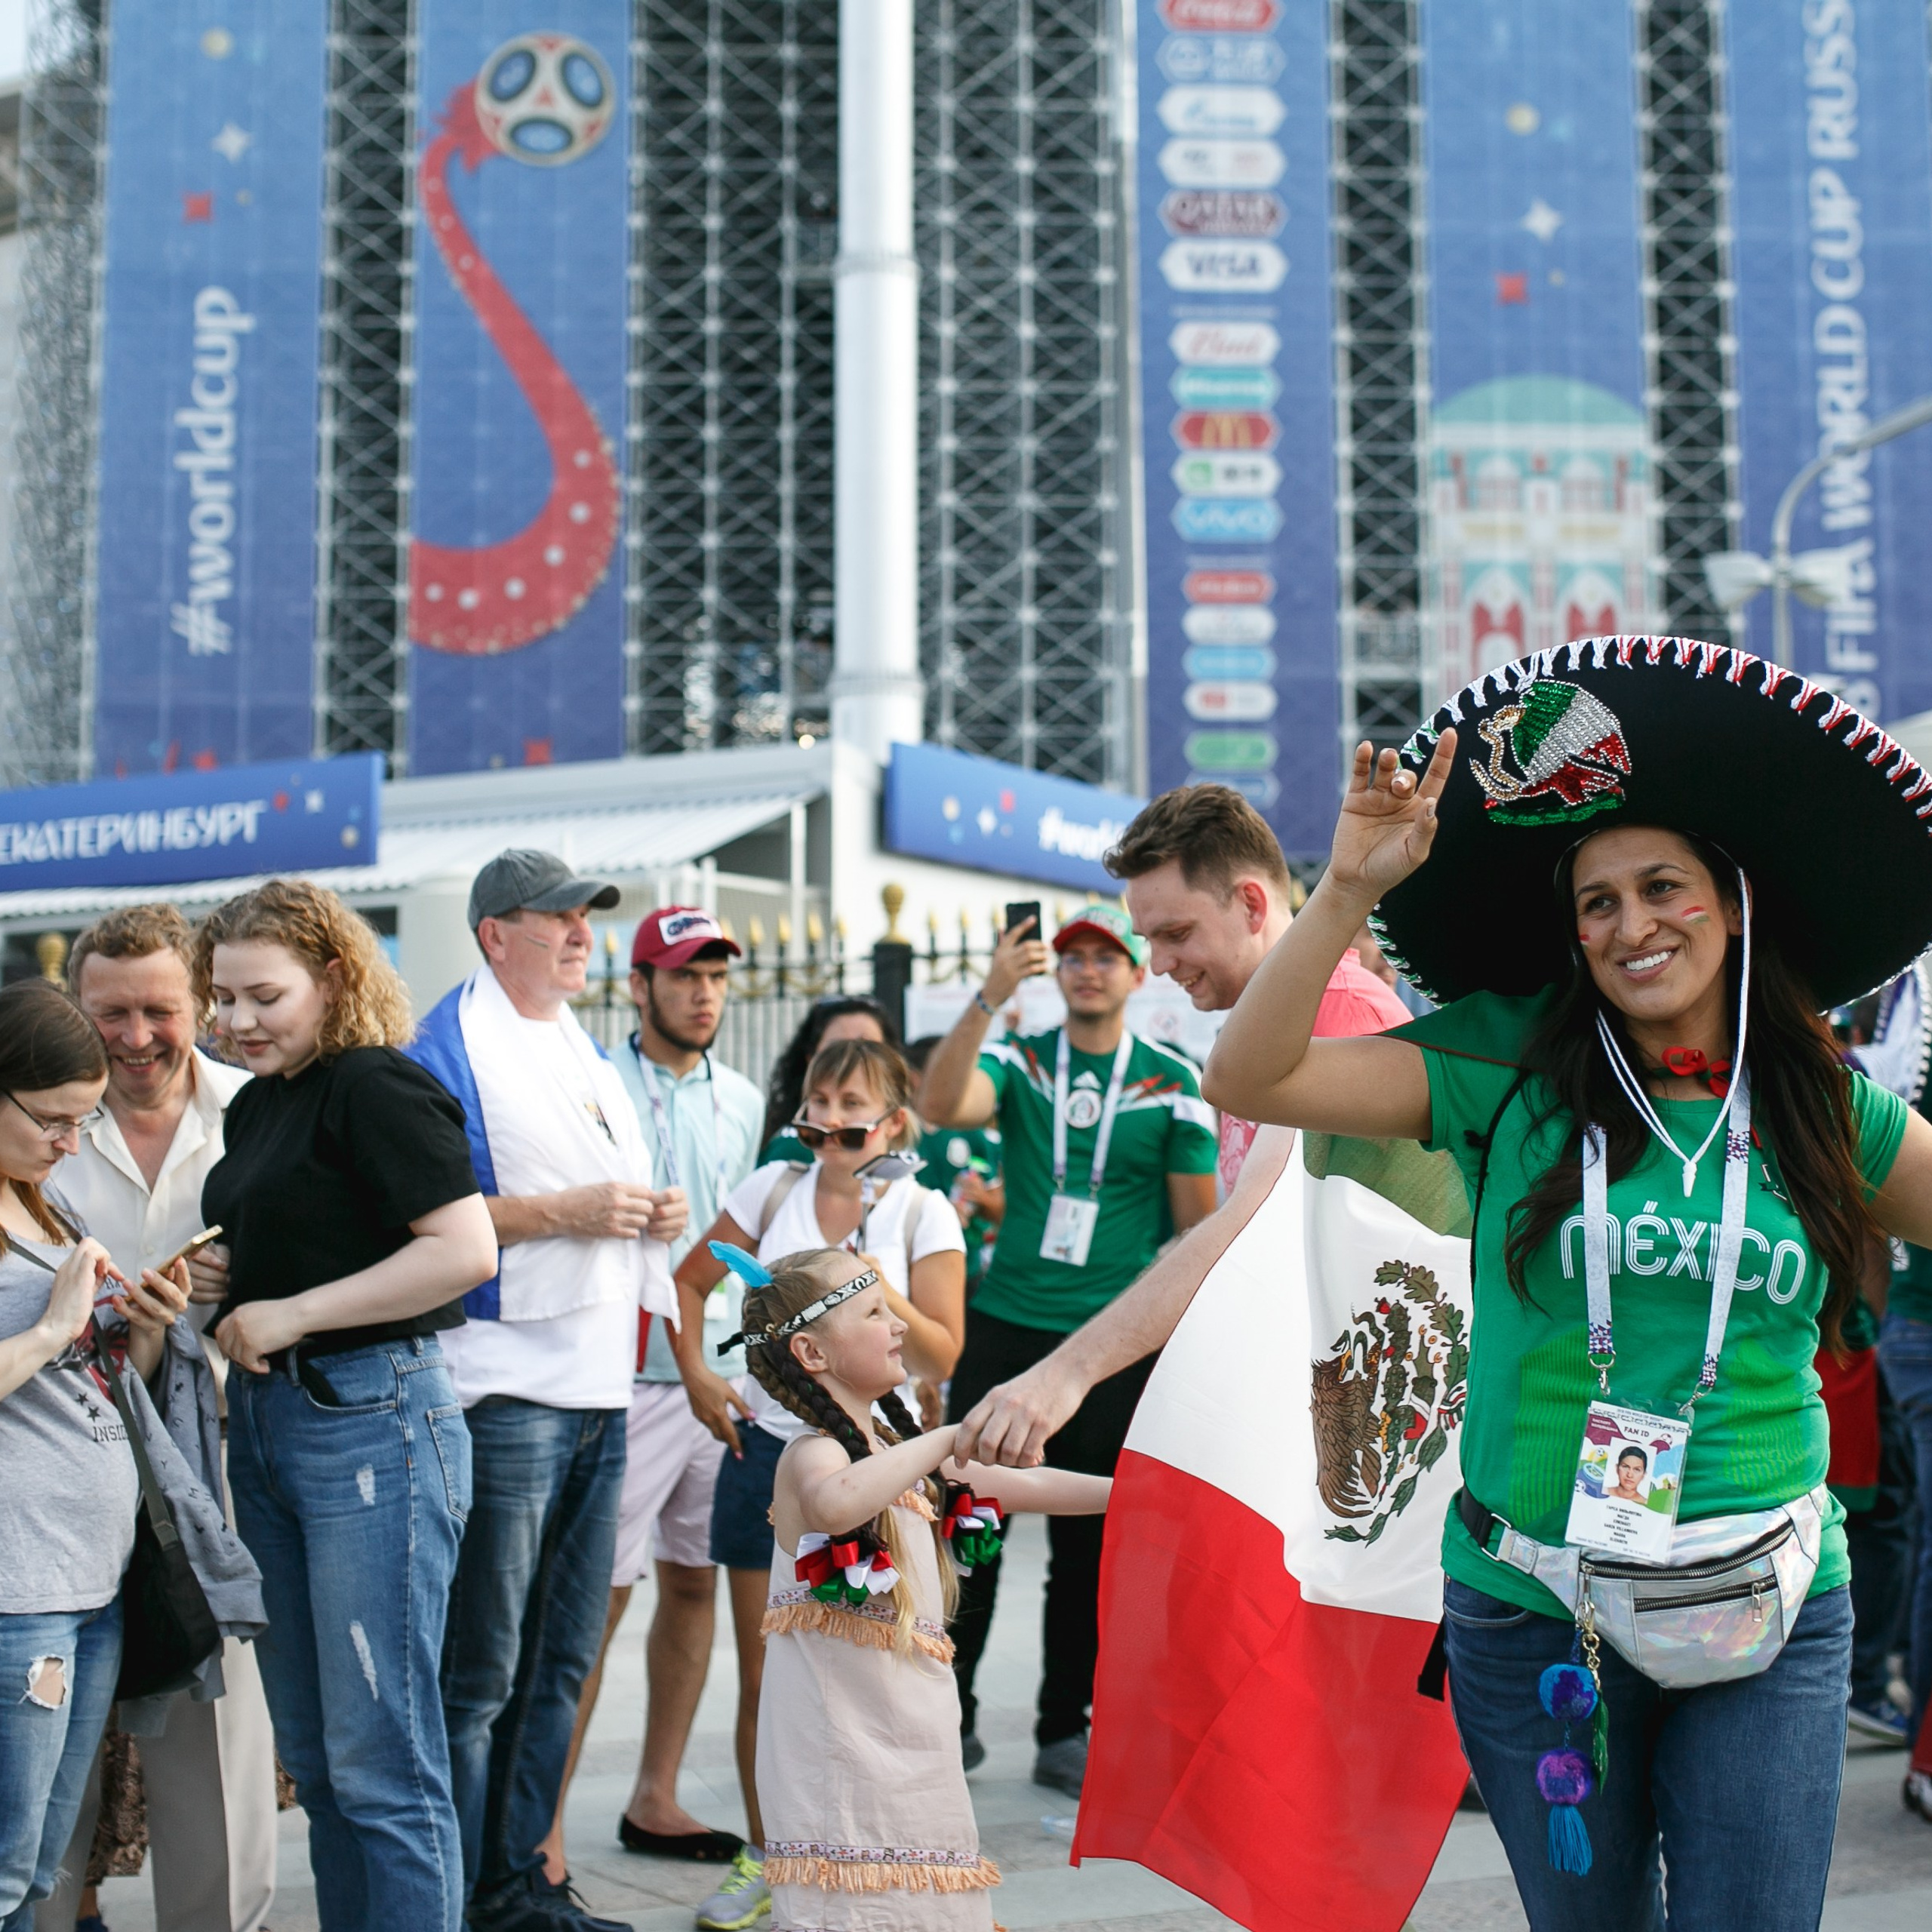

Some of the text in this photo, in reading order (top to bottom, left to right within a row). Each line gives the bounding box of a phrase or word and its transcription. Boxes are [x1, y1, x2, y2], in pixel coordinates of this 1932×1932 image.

[1808, 168, 1865, 302] CUP
[171, 285, 257, 656] #worldcup
[1813, 304, 1874, 531] WORLD
[0, 800, 268, 865] ЕКАТЕРИНБУРГ
[1560, 1200, 1807, 1305] MÉXICO
[1623, 1426, 1639, 1435] FAN
